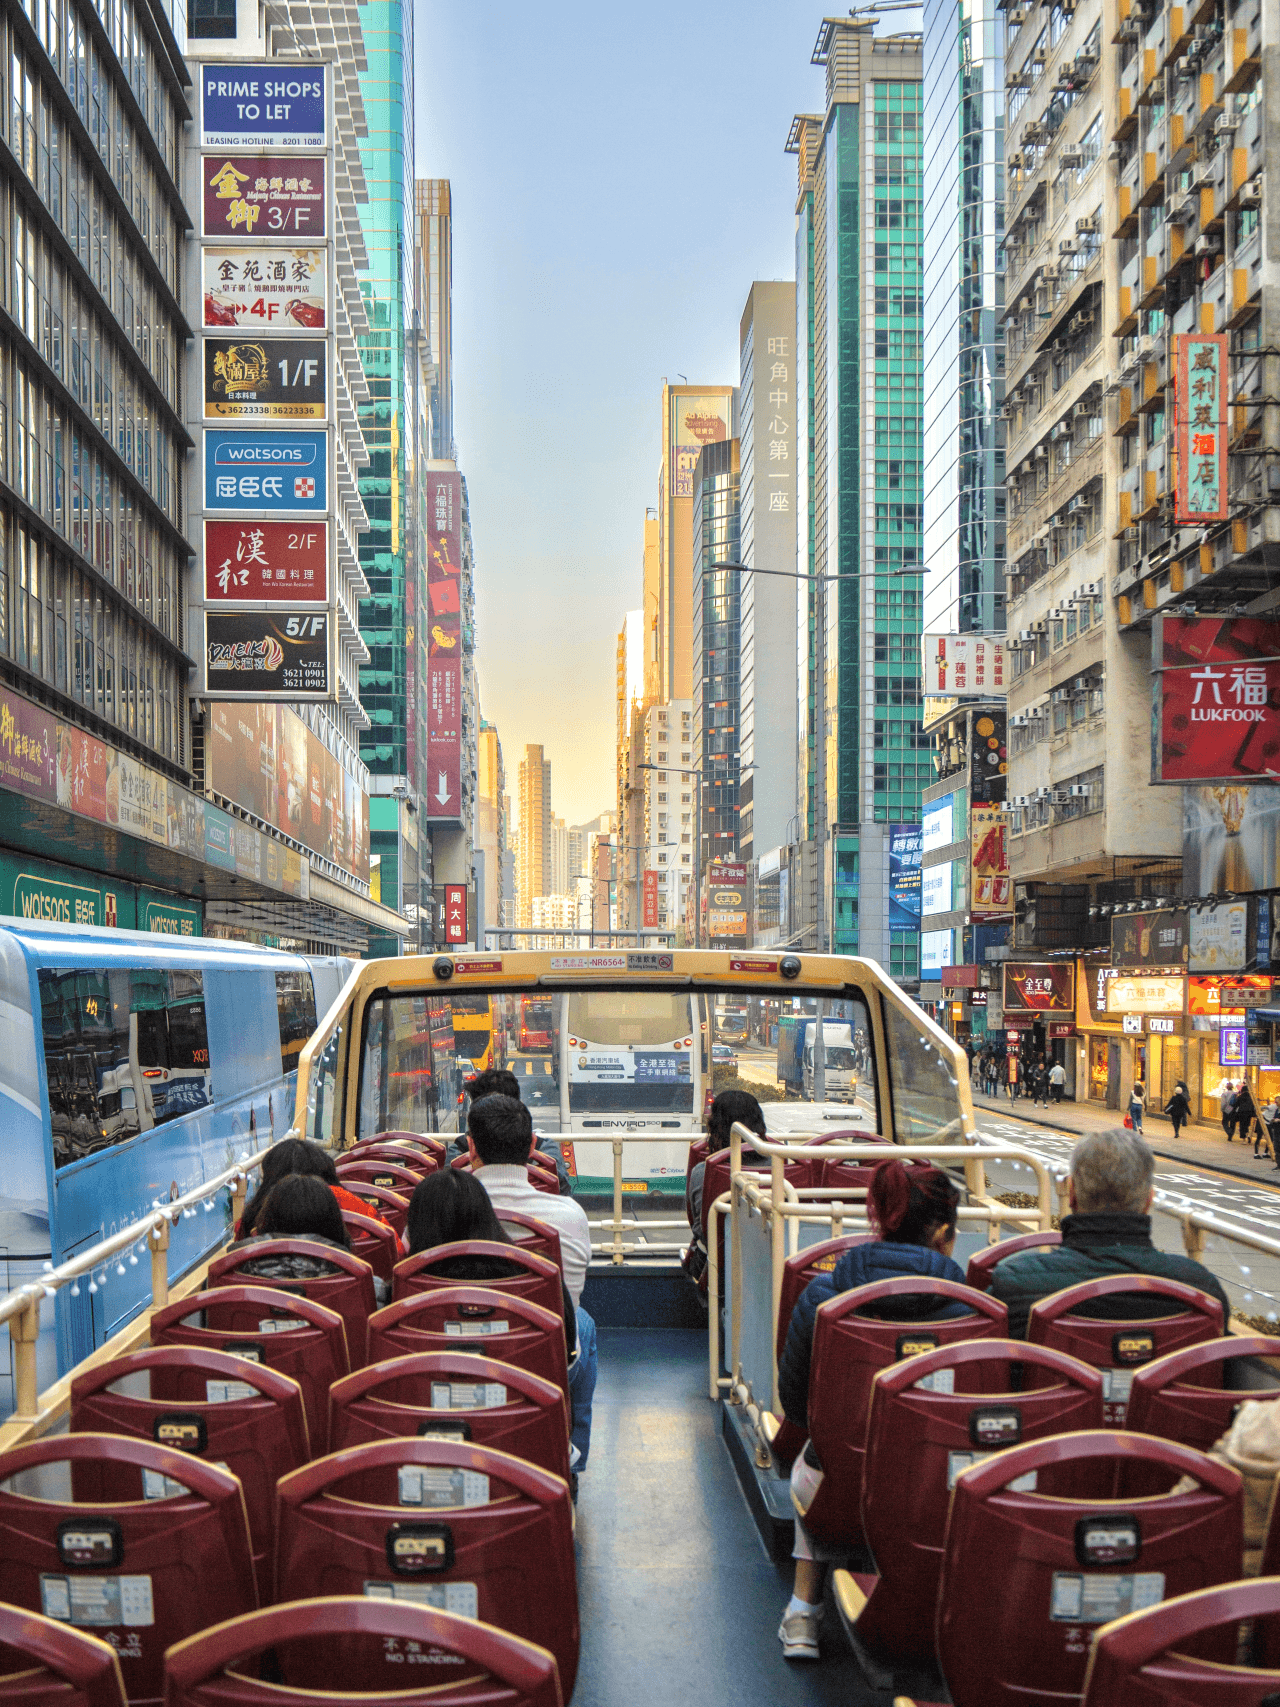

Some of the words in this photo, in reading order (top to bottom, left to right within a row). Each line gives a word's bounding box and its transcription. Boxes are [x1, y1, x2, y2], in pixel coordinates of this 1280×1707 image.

[207, 81, 259, 97] PRIME
[264, 81, 321, 98] SHOPS
[237, 104, 260, 120] TO
[266, 104, 291, 119] LET
[206, 137, 240, 145] LEASING
[242, 137, 274, 145] HOTLINE
[267, 206, 311, 231] 3/F
[217, 260, 312, 282] 金苑酒家
[250, 298, 280, 321] 4F
[278, 359, 318, 387] 1/F
[228, 391, 257, 400] 日本料理
[768, 336, 790, 512] 旺角中心第一座
[228, 447, 302, 459] watsons
[216, 476, 283, 498] 屈臣氏
[435, 483, 447, 531] 六福珠寶
[288, 534, 318, 549] 2/F
[215, 528, 269, 594] 漢和
[262, 569, 314, 580] 韓國料理
[285, 617, 325, 636] 5/F
[208, 641, 267, 666] DAIEIKI
[283, 669, 303, 677] 3621
[305, 669, 325, 677] 0901
[283, 679, 303, 687] 3621
[305, 679, 325, 687] 0902
[1190, 666, 1267, 706] 六福
[1191, 708, 1266, 722] LUKFOOK
[43, 728, 54, 786] 3/F
[21, 890, 70, 923] watsons
[450, 891, 462, 937] 周大福
[150, 914, 178, 935] watsons
[591, 958, 623, 966] NR6564
[628, 955, 657, 963] 不准飲食
[1025, 977, 1052, 991] 金至尊
[639, 1058, 677, 1068] 全港至強
[602, 1120, 646, 1128] ENVIRO
